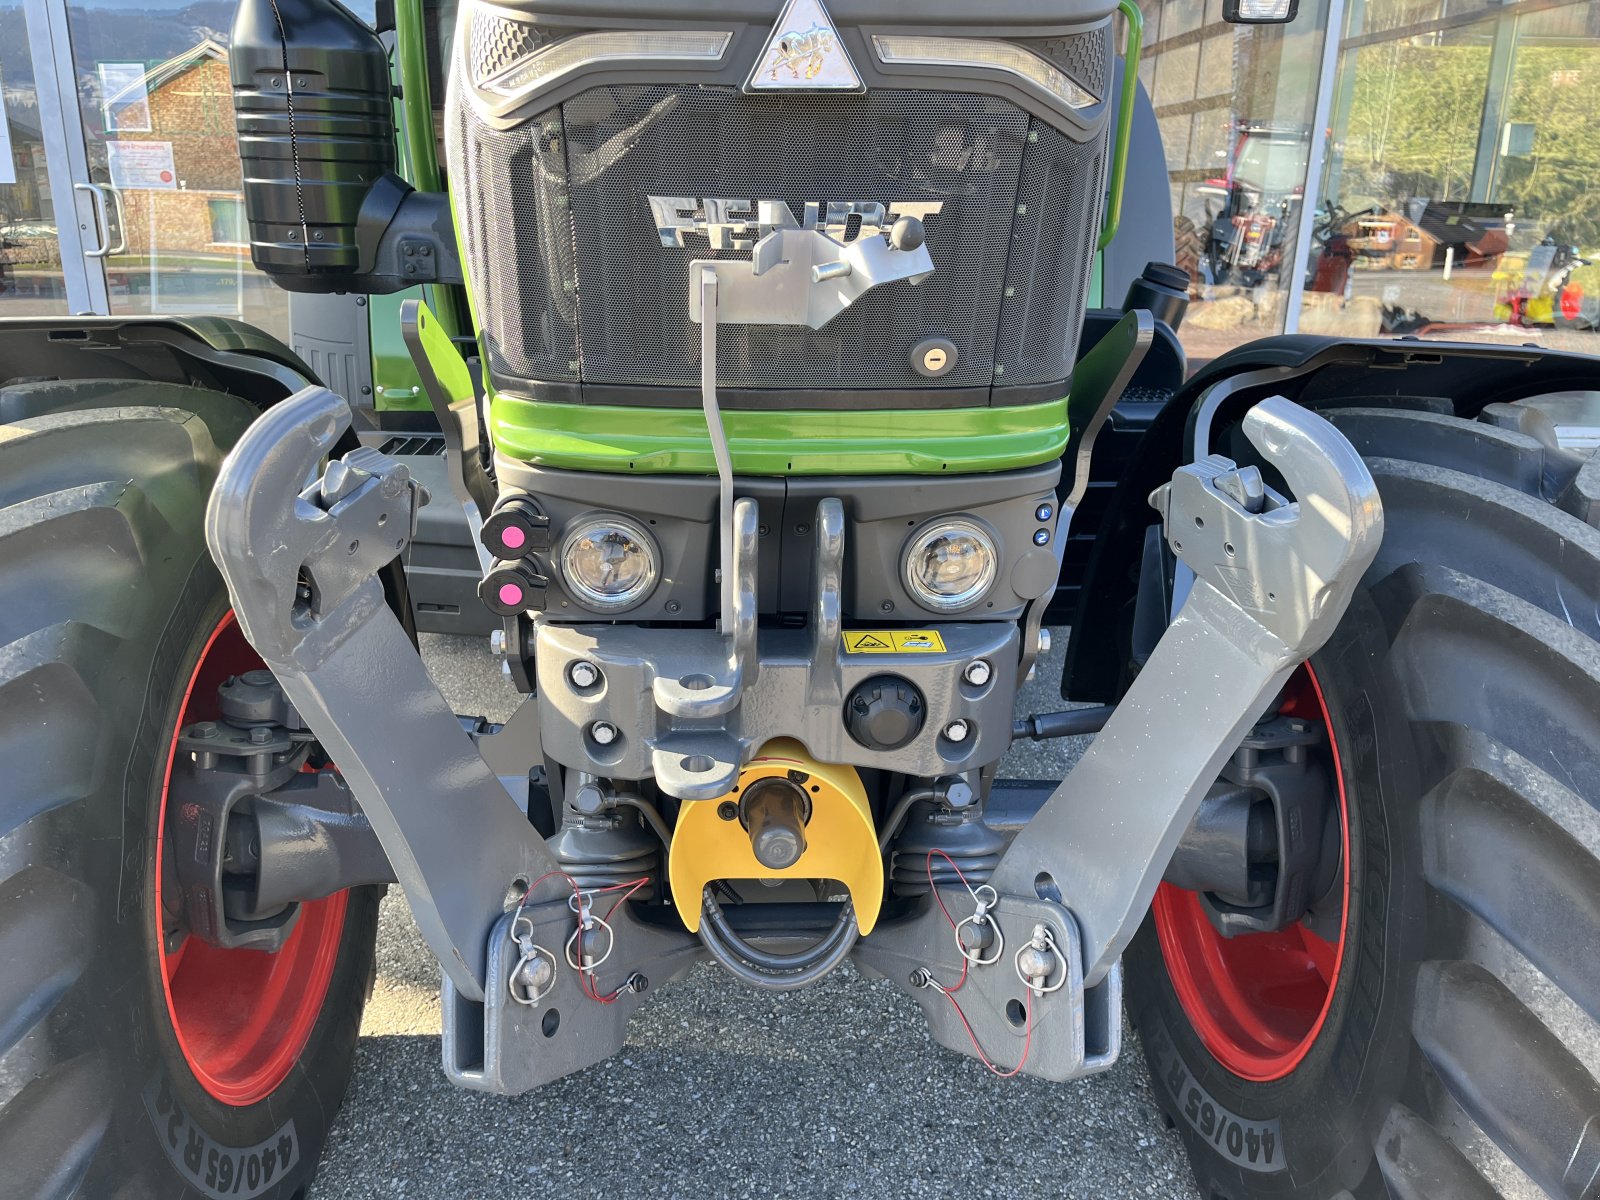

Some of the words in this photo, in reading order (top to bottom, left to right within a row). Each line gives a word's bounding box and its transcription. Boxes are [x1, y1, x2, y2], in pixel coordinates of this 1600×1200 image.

[647, 195, 943, 250] FENDT
[1185, 1087, 1275, 1164] 440/65
[205, 1134, 293, 1194] 440/65
